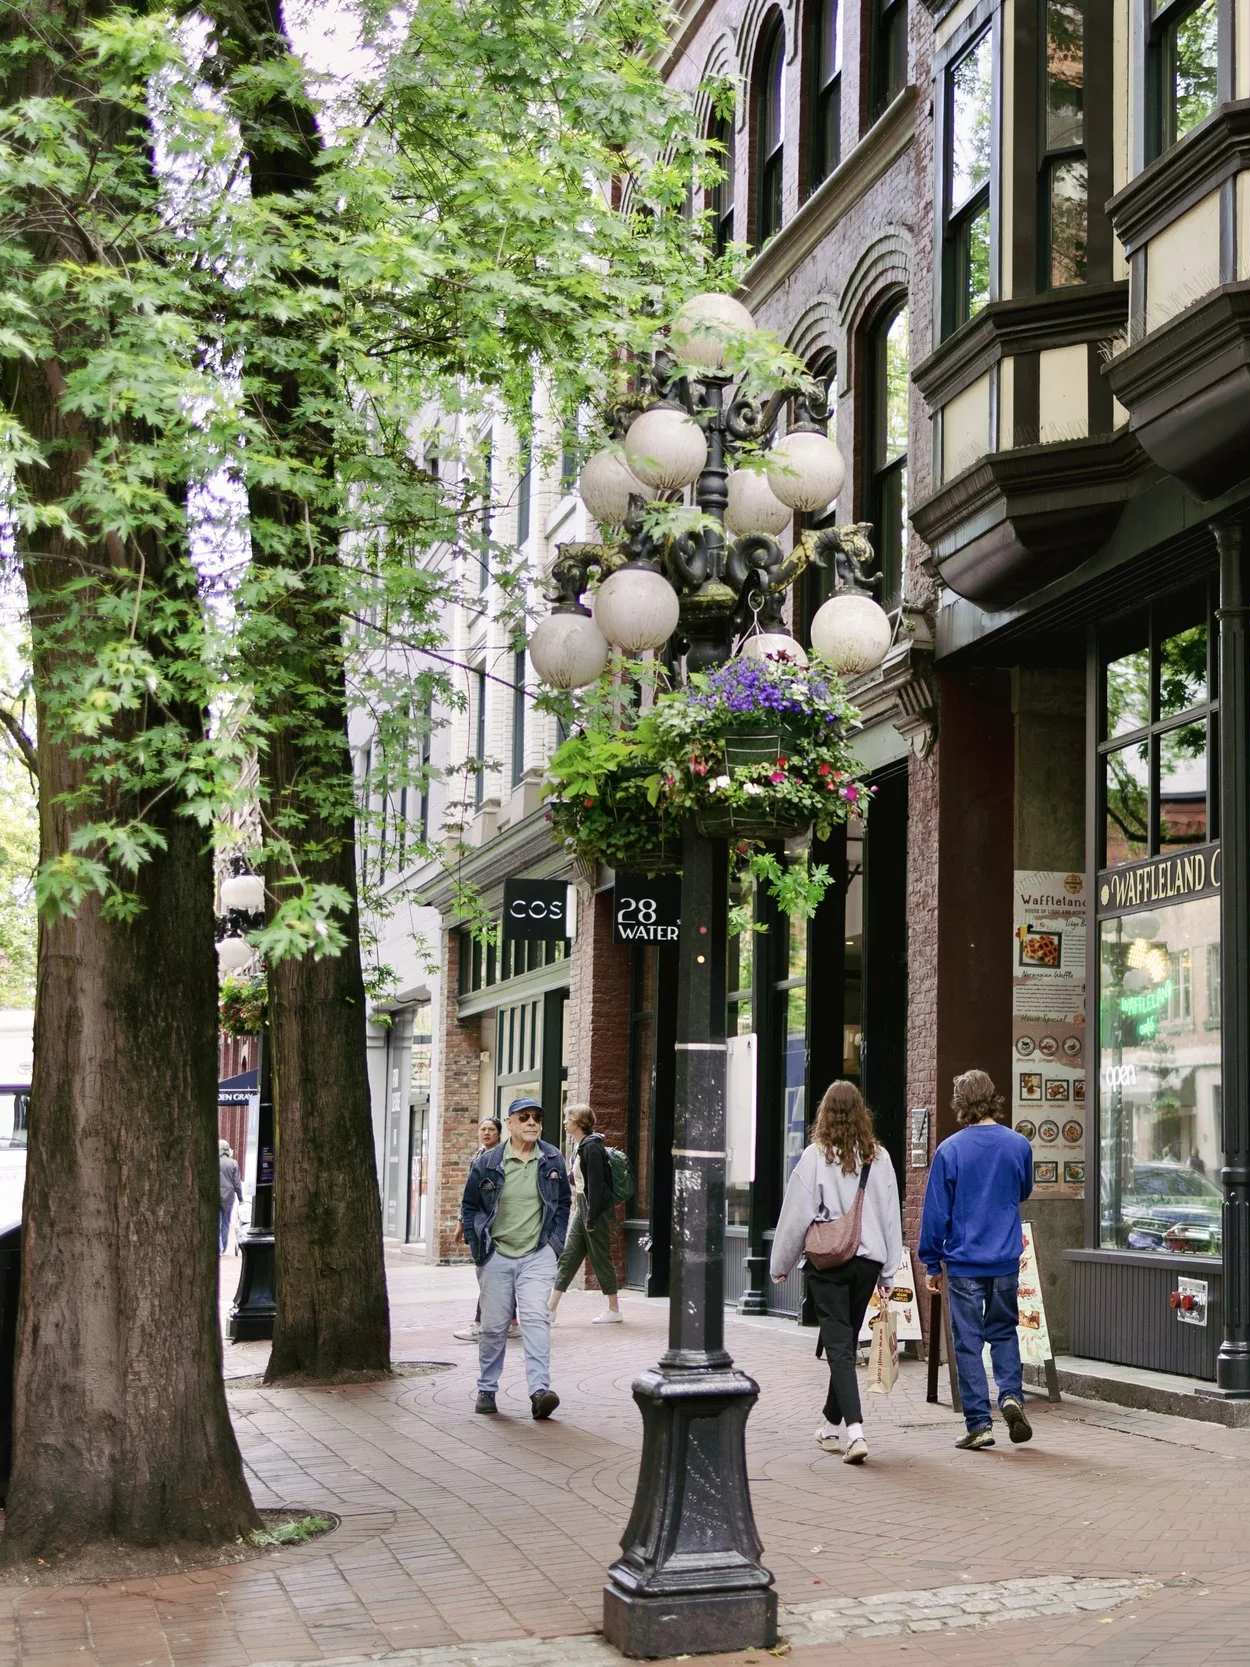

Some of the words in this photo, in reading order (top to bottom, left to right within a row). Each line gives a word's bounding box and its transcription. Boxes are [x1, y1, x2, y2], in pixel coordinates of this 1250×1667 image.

[1111, 854, 1206, 908] WAFFLELAND
[509, 900, 563, 919] COS
[617, 898, 657, 924] 28
[618, 925, 678, 940] WATER
[1106, 1064, 1136, 1092] open
